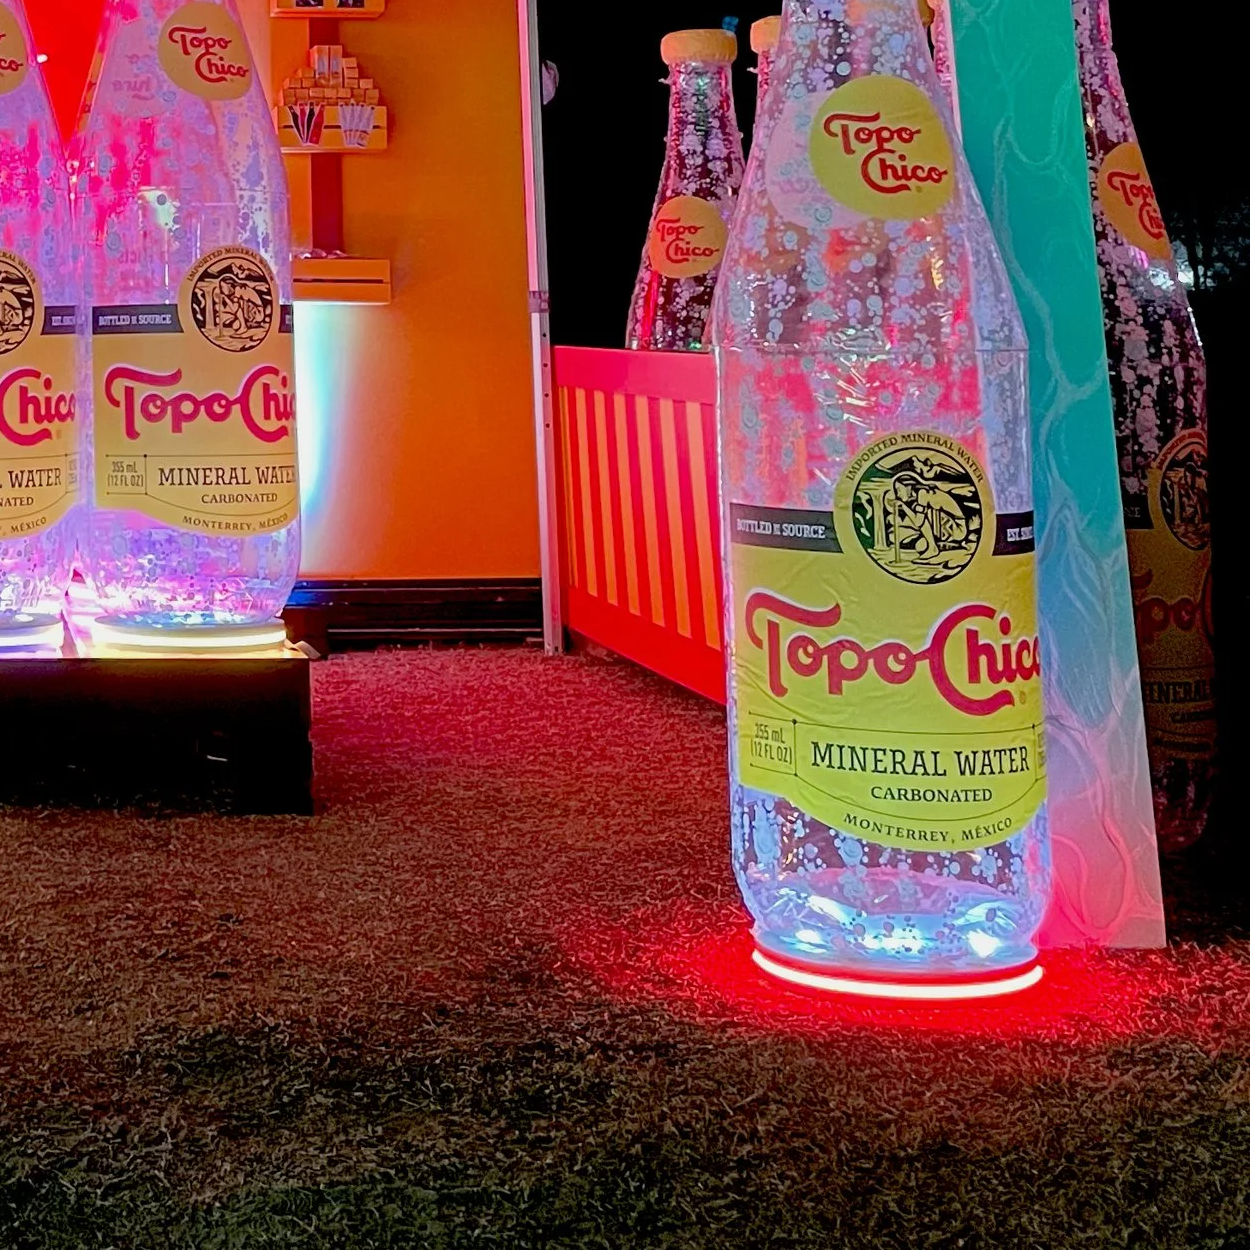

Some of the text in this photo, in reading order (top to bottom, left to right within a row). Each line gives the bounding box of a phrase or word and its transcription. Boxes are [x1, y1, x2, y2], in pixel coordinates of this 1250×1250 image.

[168, 26, 232, 55] Topo
[195, 52, 249, 83] Chico
[823, 111, 921, 155] Topo
[861, 149, 948, 194] Chico
[656, 217, 704, 242] Topo
[665, 238, 720, 263] Chico
[139, 314, 172, 325] SOURCE
[105, 367, 233, 440] Topo
[111, 461, 124, 473] 355
[846, 434, 983, 482] IMPORTED MINERAL WATER
[10, 468, 62, 488] WATER
[158, 467, 251, 486] MINERAL
[201, 493, 278, 504] CARBONATED
[11, 516, 47, 533] MÉXICO
[182, 515, 255, 532] MONTERREY,
[736, 518, 772, 534] BOTTLED
[782, 524, 825, 538] SOURCE
[745, 592, 918, 697] Topo
[755, 723, 786, 744] 355 mL
[751, 738, 792, 764] (12 FL OZ)
[811, 742, 946, 777] MINERAL
[954, 746, 1030, 776] WATER
[871, 786, 992, 802] CARBONATED
[843, 813, 1012, 844] MONTERREY, MÉXICO
